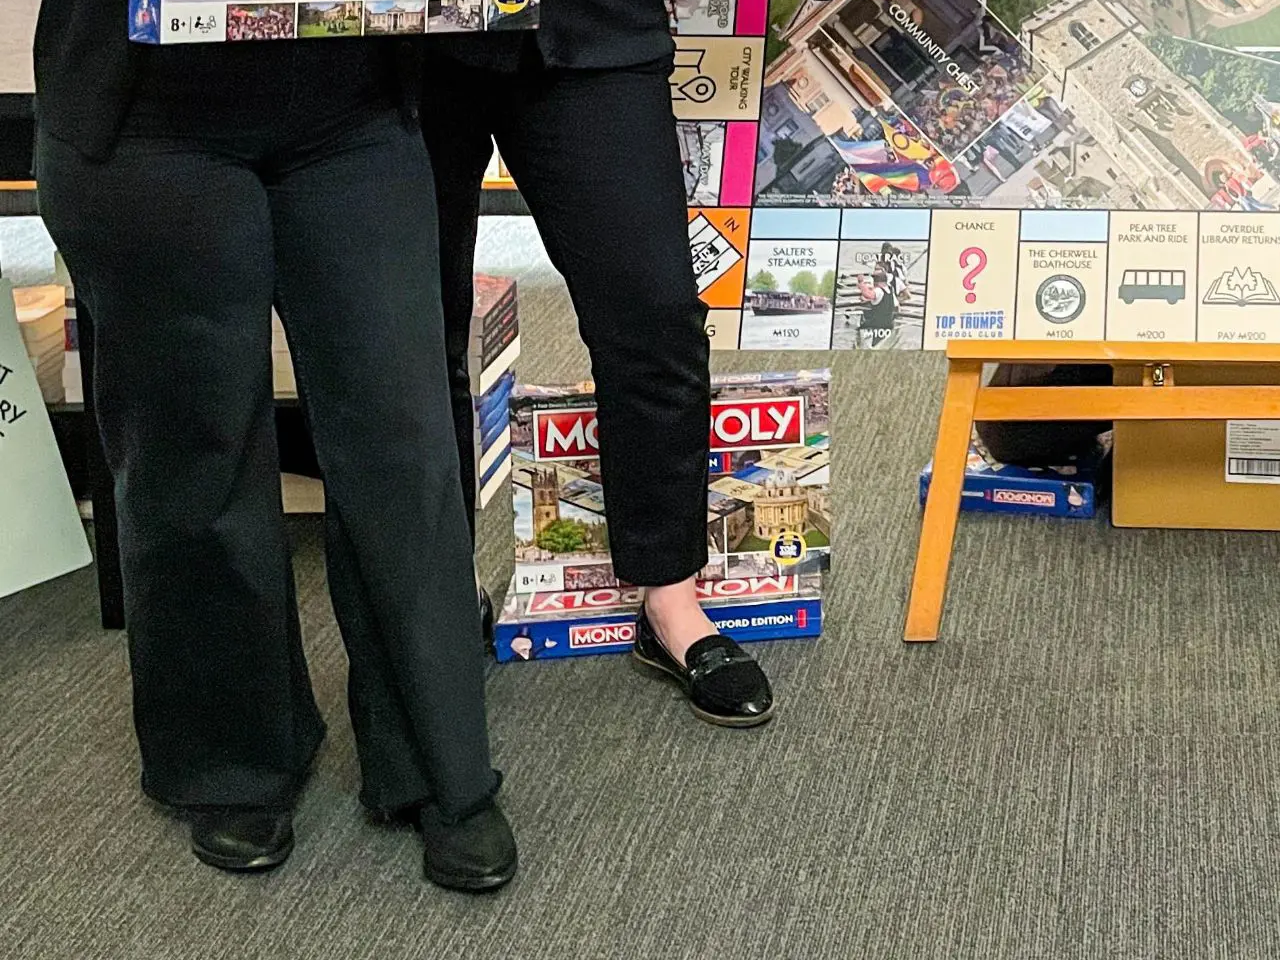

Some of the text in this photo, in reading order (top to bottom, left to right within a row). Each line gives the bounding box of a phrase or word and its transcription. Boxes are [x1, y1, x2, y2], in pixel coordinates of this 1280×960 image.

[889, 3, 981, 95] COMMUNITY CHEST
[729, 66, 740, 91] TOUR
[738, 46, 752, 110] CITY WALKING
[724, 216, 740, 233] IN
[954, 221, 996, 231] CHANCE
[1129, 224, 1177, 233] PEAR TREE
[1220, 225, 1265, 234] OVERDUE
[1118, 234, 1189, 244] PARK AND RIDE
[1201, 235, 1239, 245] LIBRARY
[772, 247, 814, 257] SALTER'S
[1028, 249, 1099, 259] THE CHERWELL
[767, 257, 817, 267] STEAMERS
[856, 252, 911, 263] BOAT RACE
[1033, 259, 1093, 270] BOATHOUSE
[935, 315, 1005, 330] TOP TRUMPS
[935, 330, 973, 338] SCHOOL
[1217, 331, 1236, 340] PAY
[995, 490, 1054, 506] MONOPOLY
[750, 613, 794, 628] EDITION
